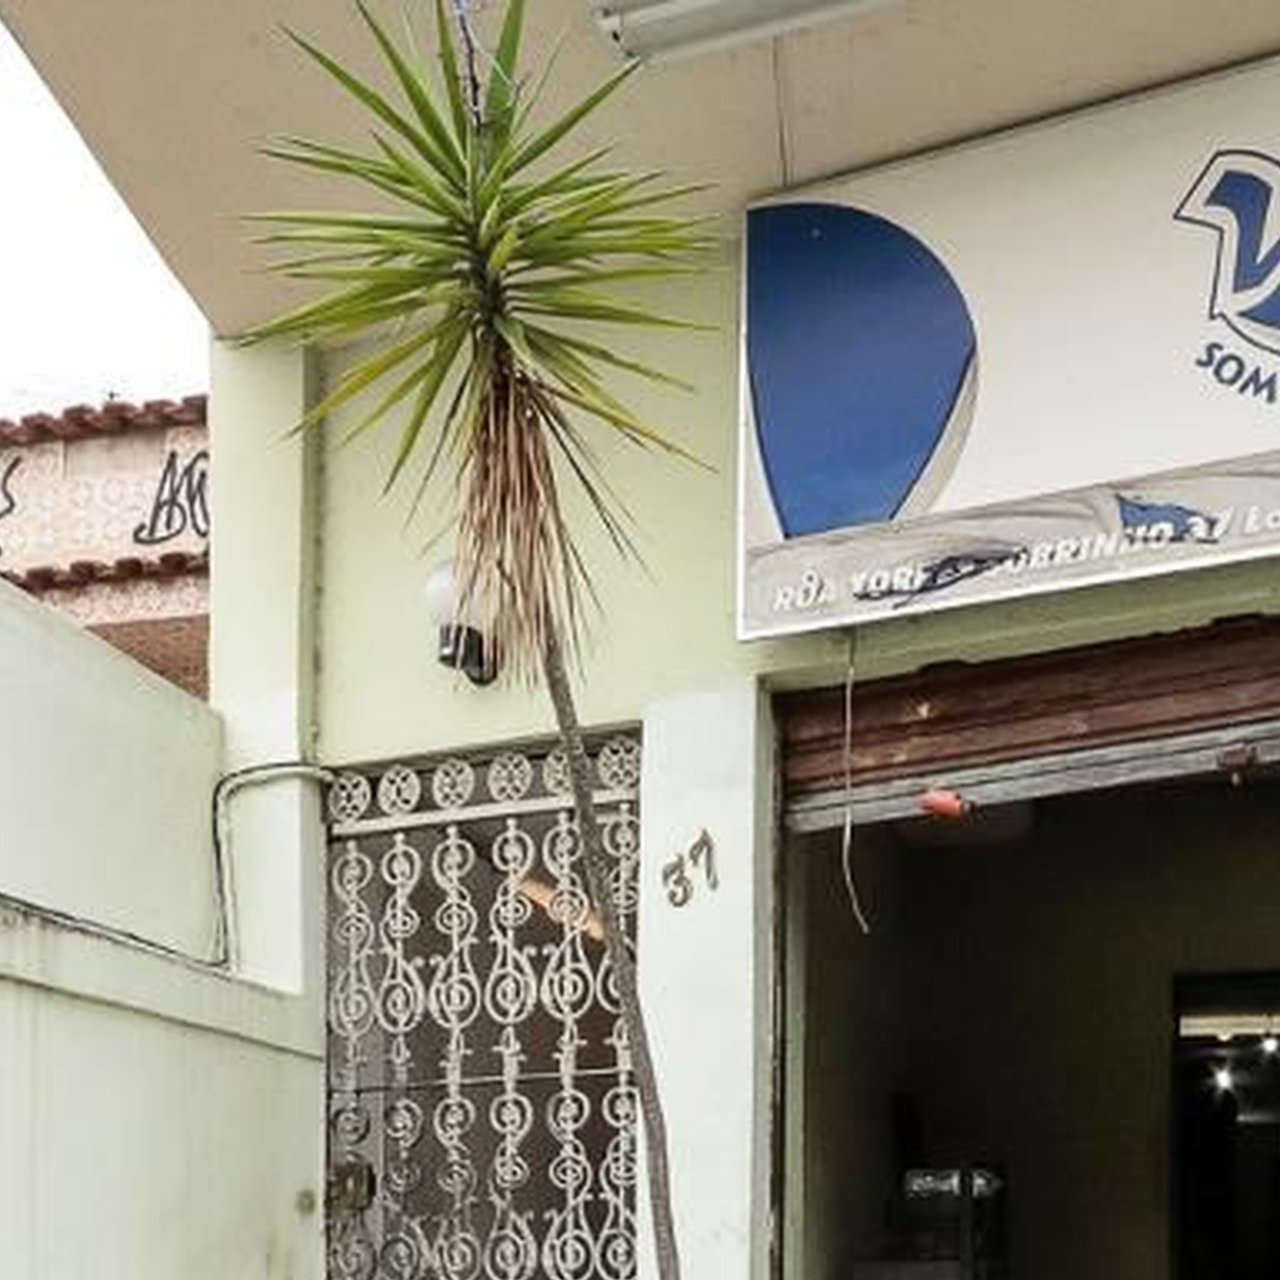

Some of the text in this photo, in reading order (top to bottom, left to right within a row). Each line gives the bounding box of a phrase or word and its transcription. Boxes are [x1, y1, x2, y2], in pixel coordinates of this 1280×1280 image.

[1195, 341, 1278, 403] SOM
[988, 520, 1175, 576] OBRINHO
[661, 828, 719, 908] 37
